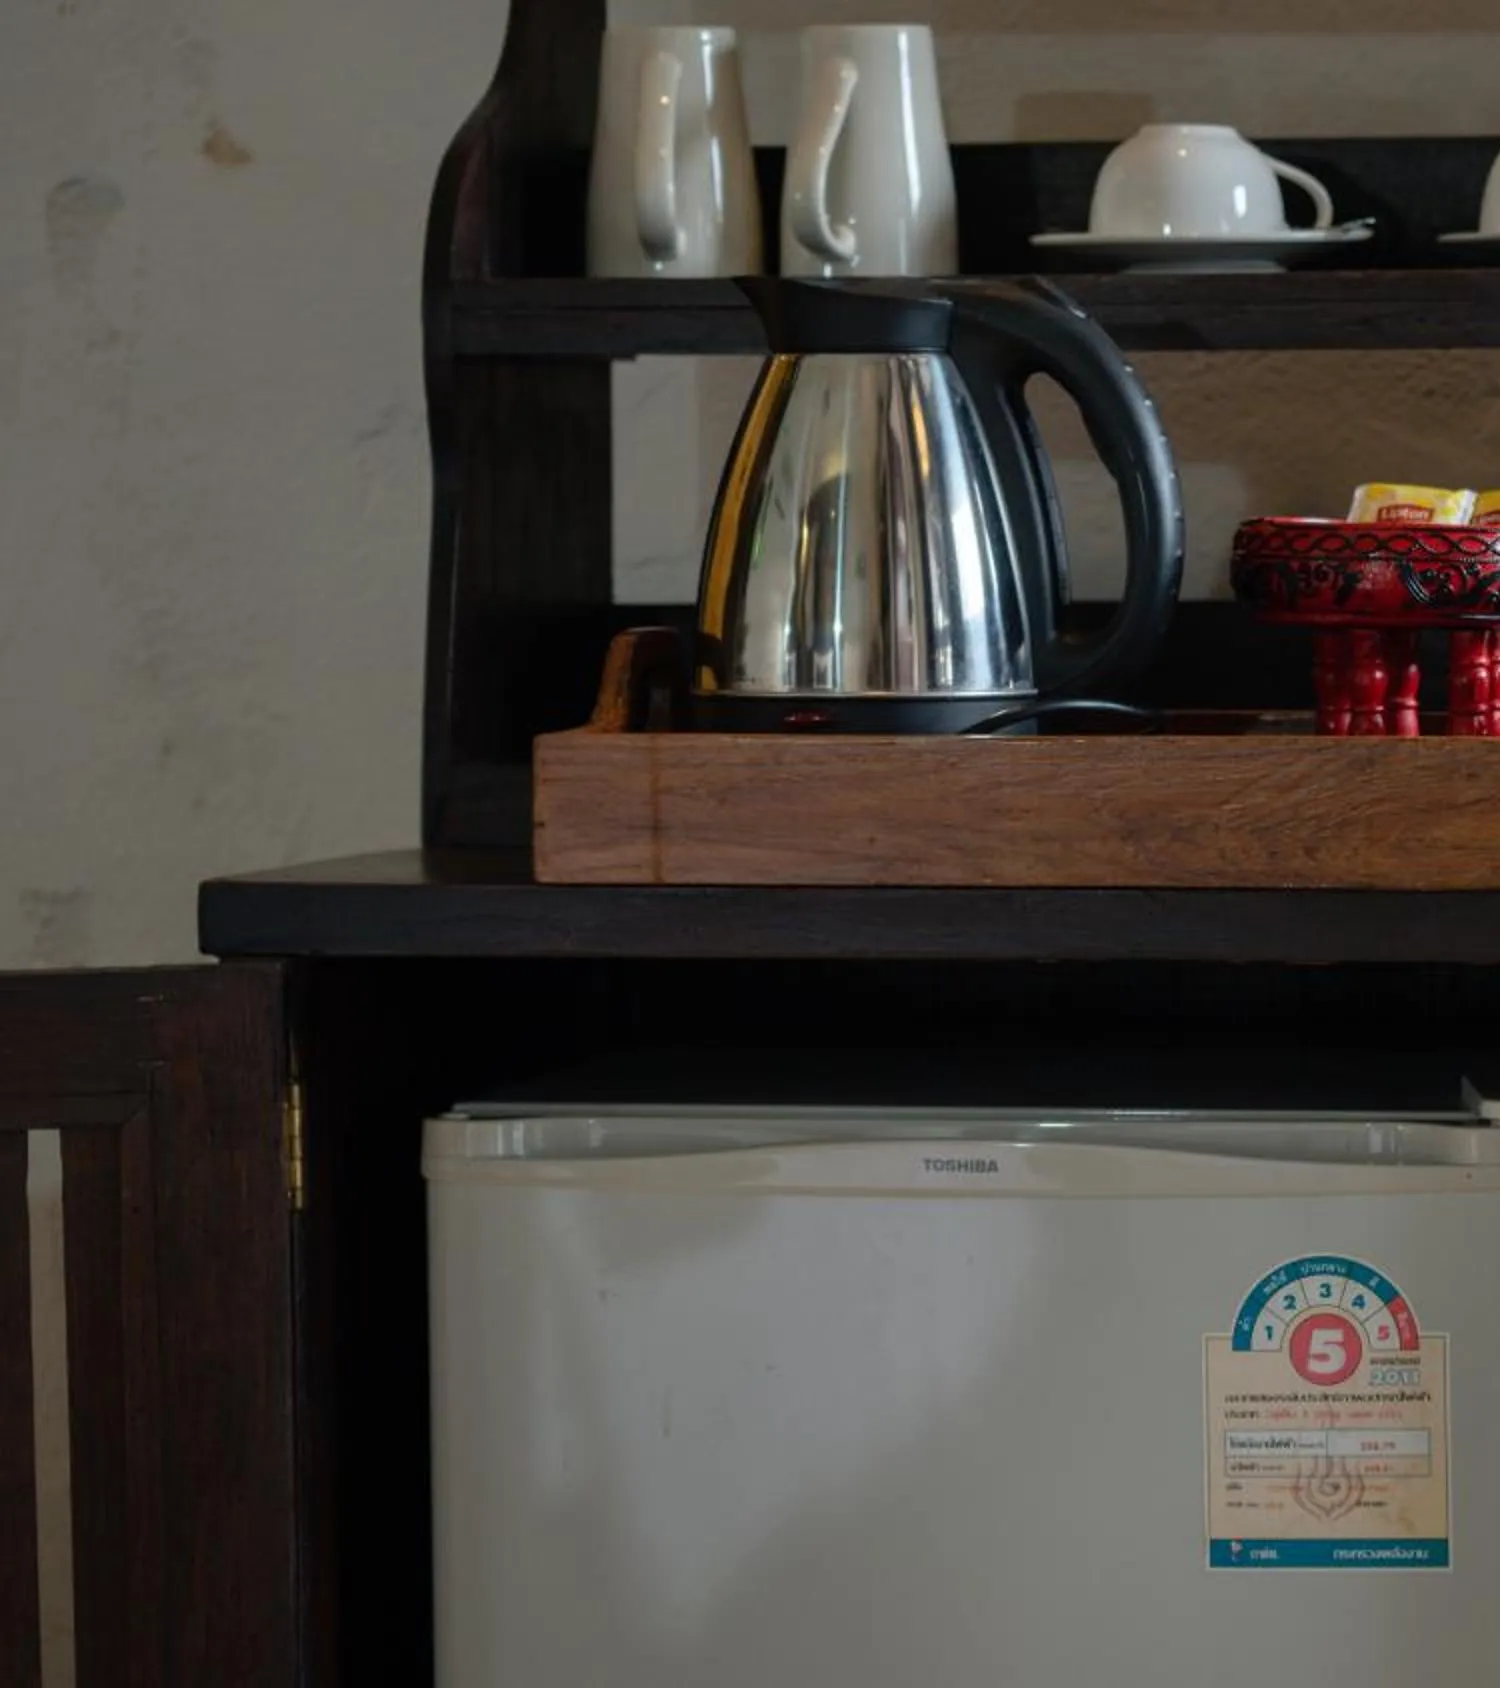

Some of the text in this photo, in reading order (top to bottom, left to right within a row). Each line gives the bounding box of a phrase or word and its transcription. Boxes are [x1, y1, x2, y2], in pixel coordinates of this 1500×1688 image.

[922, 1157, 999, 1173] TOSHIBA
[1319, 1283, 1332, 1298] 3
[1283, 1294, 1297, 1310] 2
[1351, 1294, 1367, 1309] 4
[1265, 1325, 1274, 1340] 1
[1377, 1325, 1390, 1341] 5
[1307, 1328, 1347, 1374] 5
[1368, 1368, 1421, 1386] 2011
